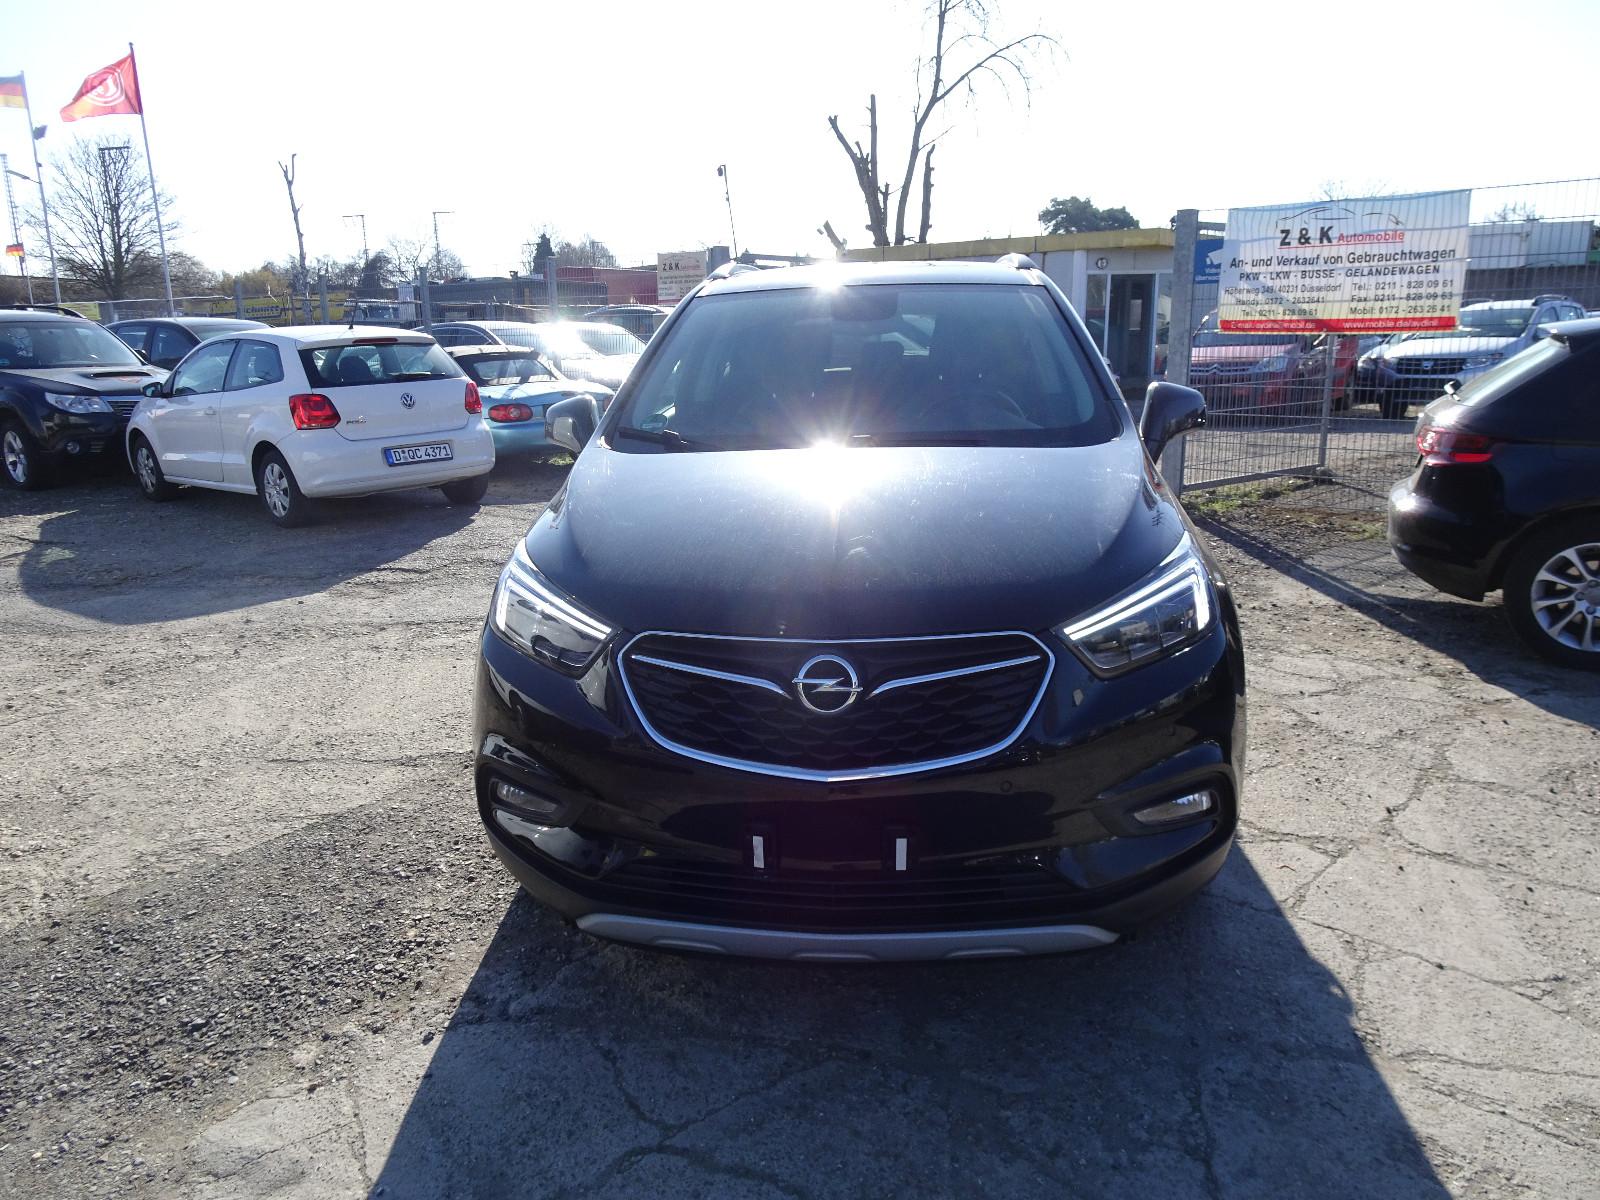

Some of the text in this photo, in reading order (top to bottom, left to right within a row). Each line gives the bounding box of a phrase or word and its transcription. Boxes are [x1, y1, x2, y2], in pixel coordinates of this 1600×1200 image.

[1280, 225, 1405, 246] Z & K Automobile
[1230, 249, 1456, 269] An- und Verkauf von Gebrauchtwagen
[1240, 272, 1260, 281] PKW
[1269, 271, 1291, 280] LKW
[1301, 269, 1335, 279] BUSSE
[1374, 281, 1397, 290] 0211
[1426, 280, 1439, 288] 09
[424, 446, 450, 457] 4371
